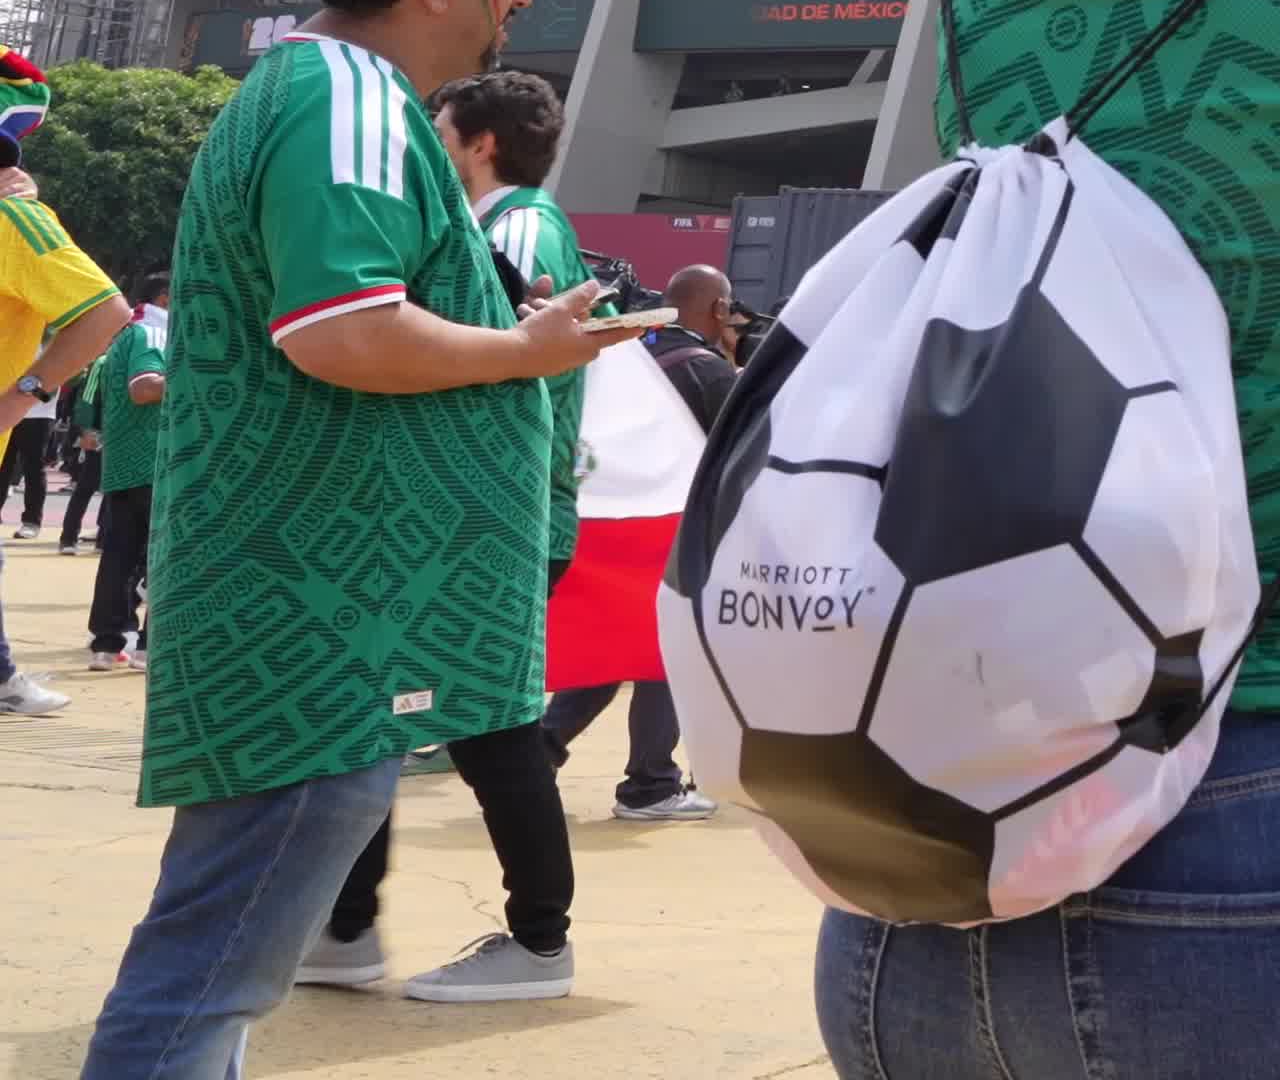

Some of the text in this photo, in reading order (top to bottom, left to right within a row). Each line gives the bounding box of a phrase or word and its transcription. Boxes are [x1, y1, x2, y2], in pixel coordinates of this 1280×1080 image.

[801, 4, 830, 20] DE
[834, 0, 911, 19] MÉXIC
[740, 561, 853, 587] MARRIOTT
[719, 589, 863, 632] BONVOY
